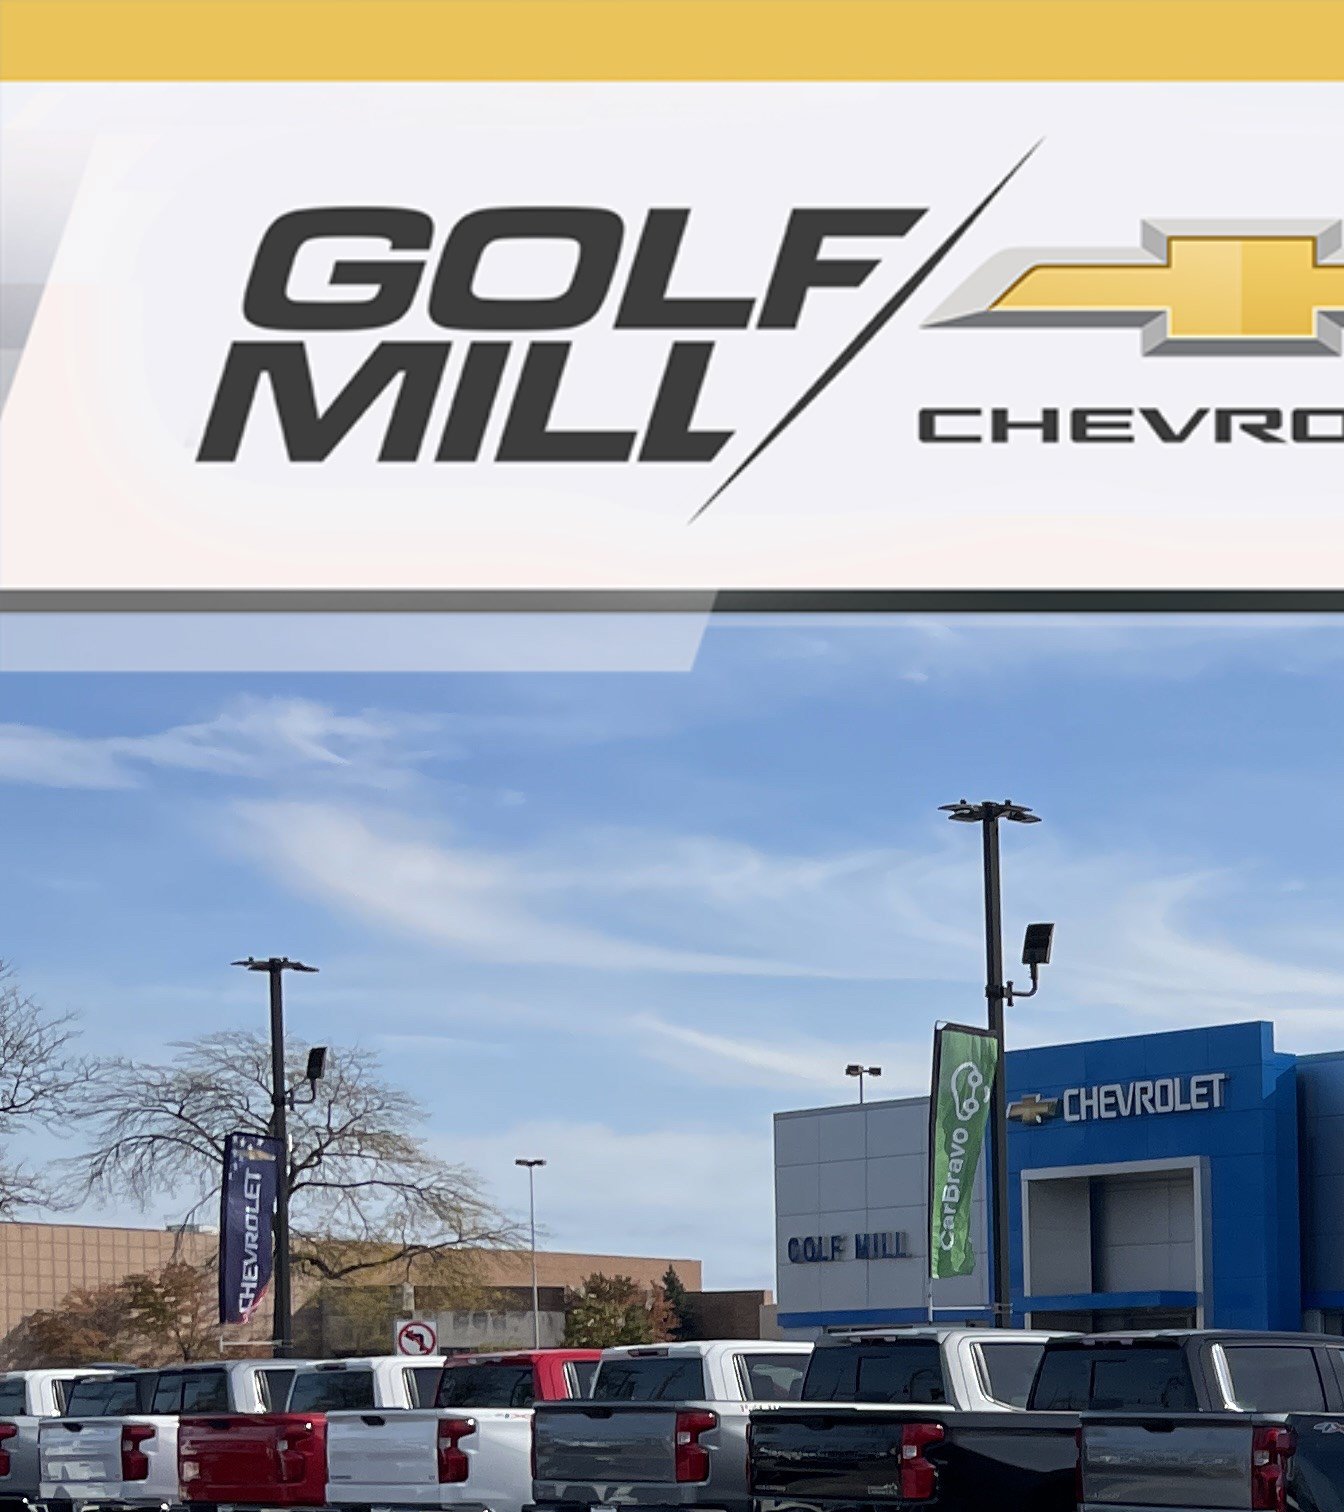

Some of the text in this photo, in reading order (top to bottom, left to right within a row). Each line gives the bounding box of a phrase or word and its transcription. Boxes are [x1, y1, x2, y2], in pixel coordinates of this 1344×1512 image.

[1063, 1072, 1226, 1123] CHEVROLET
[940, 1127, 969, 1251] CarBravo
[238, 1167, 262, 1314] CHEVROLET
[855, 1231, 912, 1260] MILL
